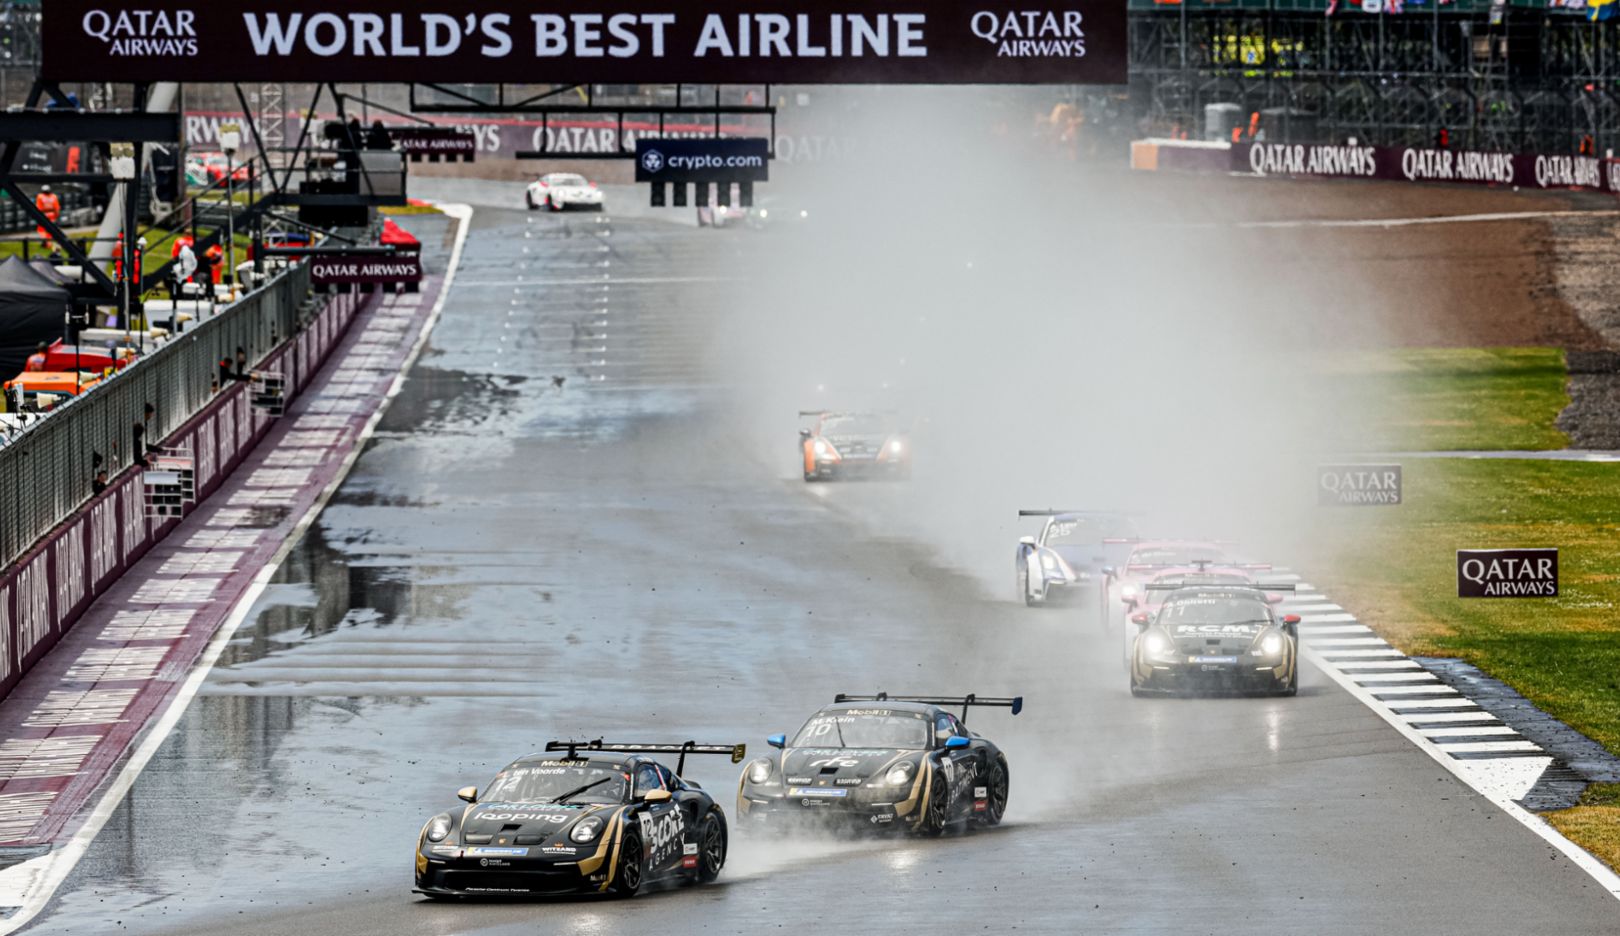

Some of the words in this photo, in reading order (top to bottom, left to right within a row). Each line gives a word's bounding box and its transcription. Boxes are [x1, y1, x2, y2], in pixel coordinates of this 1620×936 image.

[83, 10, 196, 40] QATAR
[244, 13, 512, 56] WORLD’S
[531, 13, 674, 57] BEST
[695, 13, 926, 56] AIRLINE
[971, 10, 1083, 41] QATAR
[110, 38, 198, 56] AIRWAYS
[997, 39, 1086, 57] AIRWAYS
[668, 154, 762, 170] crypto.com
[1250, 142, 1305, 175] QATAR
[1306, 144, 1376, 176] AIRWAYS
[1402, 148, 1453, 180] QATAR
[1454, 150, 1514, 183] AIRWAYS
[1535, 155, 1573, 187] QATAR
[312, 264, 357, 278] QATAR
[361, 264, 416, 275] AIRWAYS
[1321, 471, 1397, 494] QATAR
[1339, 491, 1398, 503] AIRWAYS
[1462, 558, 1553, 584] QATAR
[1484, 581, 1555, 595] AIRWAYS
[807, 724, 832, 738] 10
[494, 776, 523, 793] 12
[473, 812, 569, 824] looping
[649, 833, 686, 871] AGENCY
